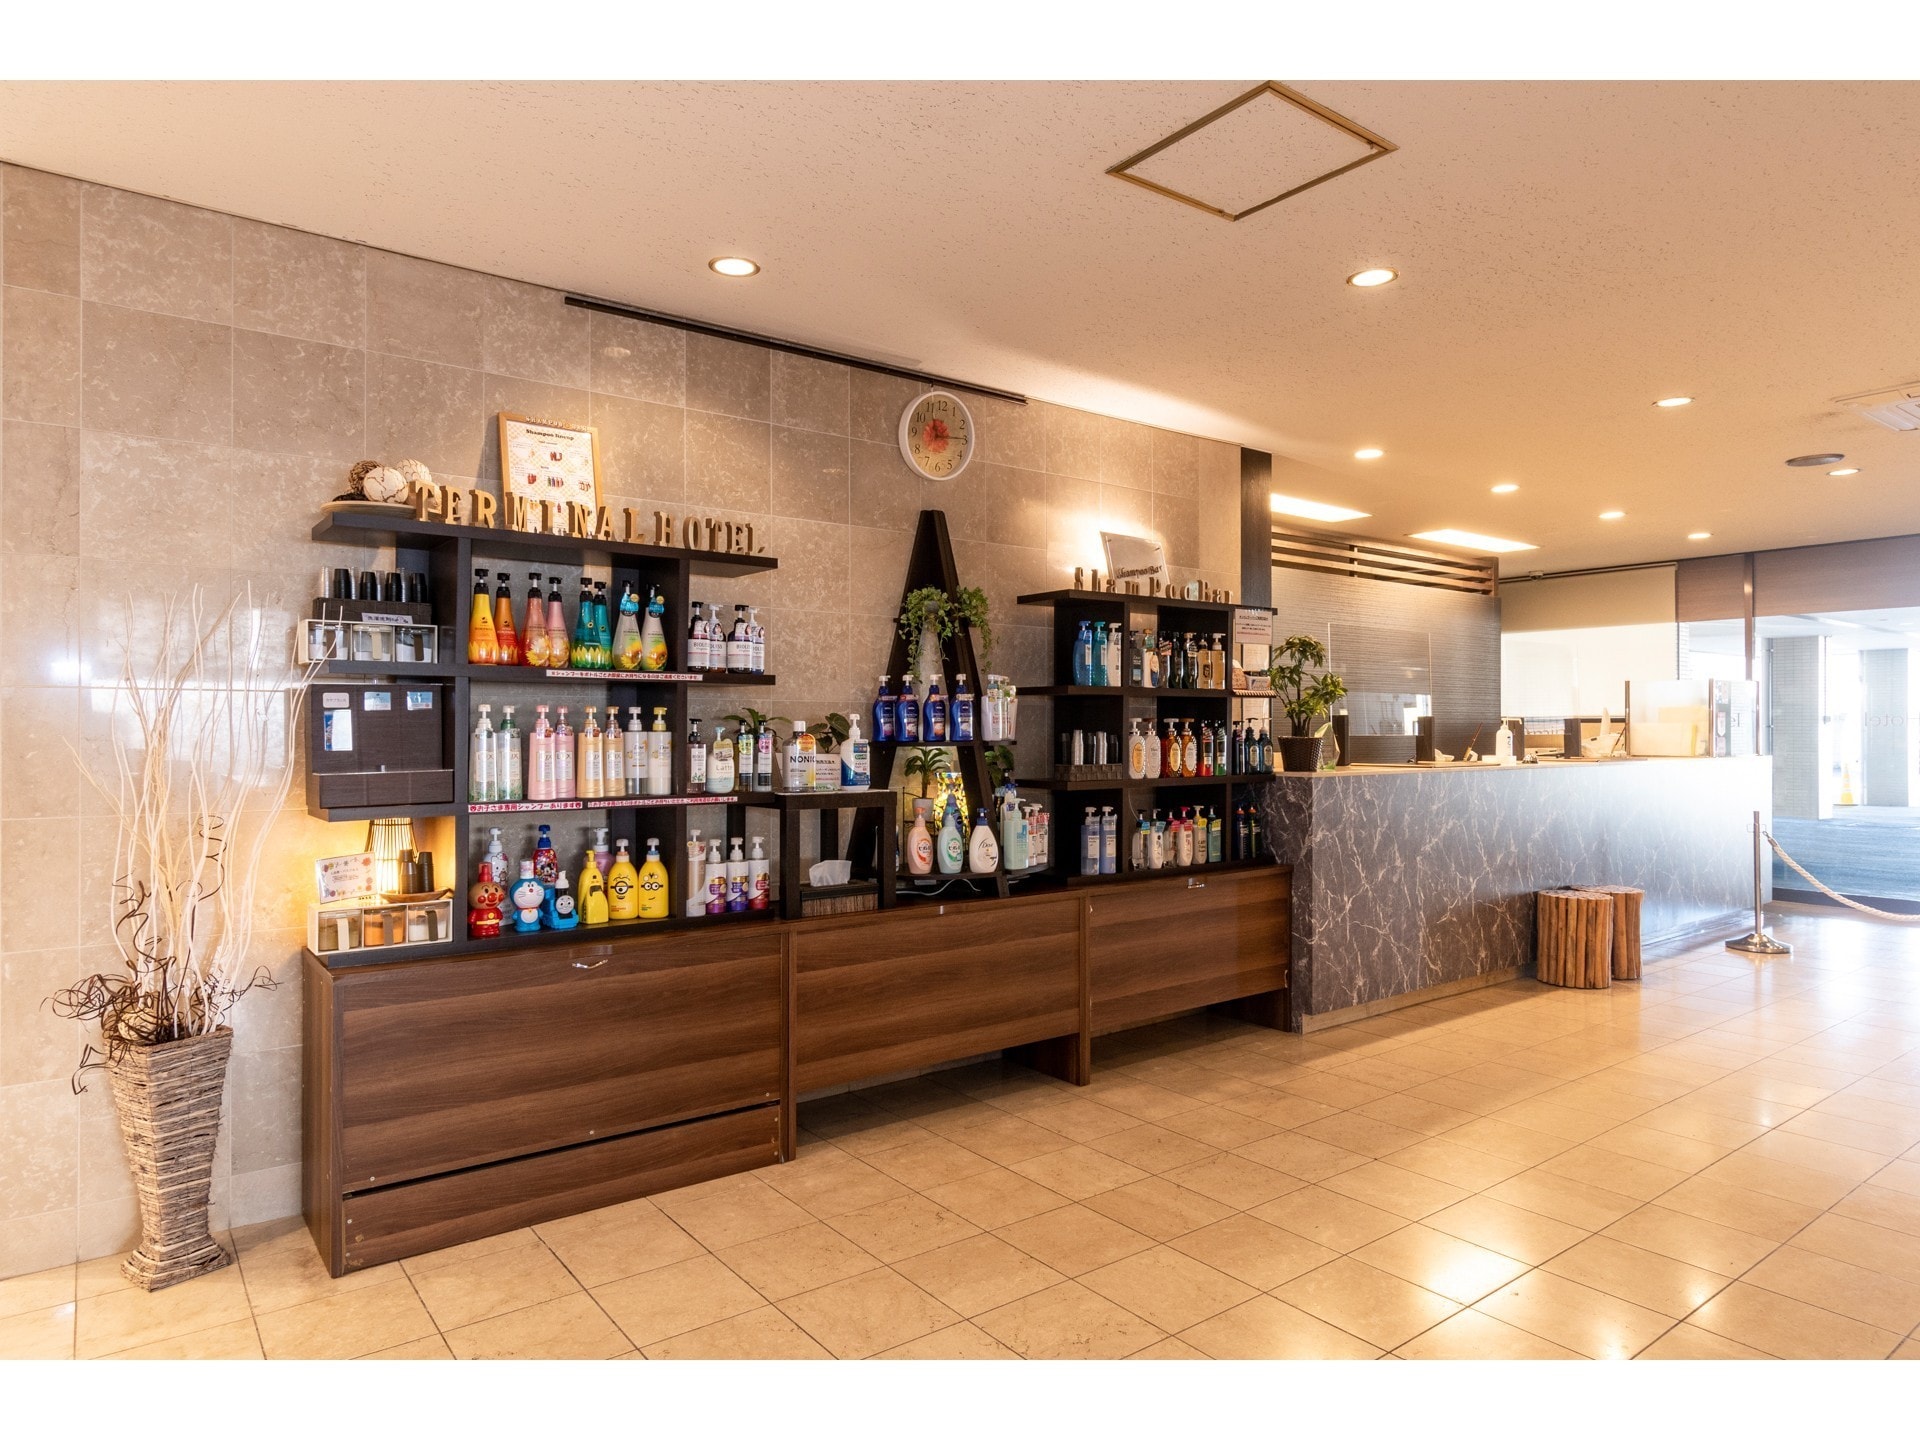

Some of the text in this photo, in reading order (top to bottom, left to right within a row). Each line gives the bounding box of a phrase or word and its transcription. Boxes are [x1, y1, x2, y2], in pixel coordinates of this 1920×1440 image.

[938, 400, 948, 412] 12
[915, 411, 926, 424] 10
[959, 419, 965, 430] 2
[911, 426, 918, 437] 9
[914, 444, 921, 454] 8
[957, 450, 963, 460] 4
[924, 456, 930, 466] 7
[935, 461, 941, 472] 6
[947, 459, 953, 470] 5
[409, 479, 766, 555] TERMINAL HOTEL
